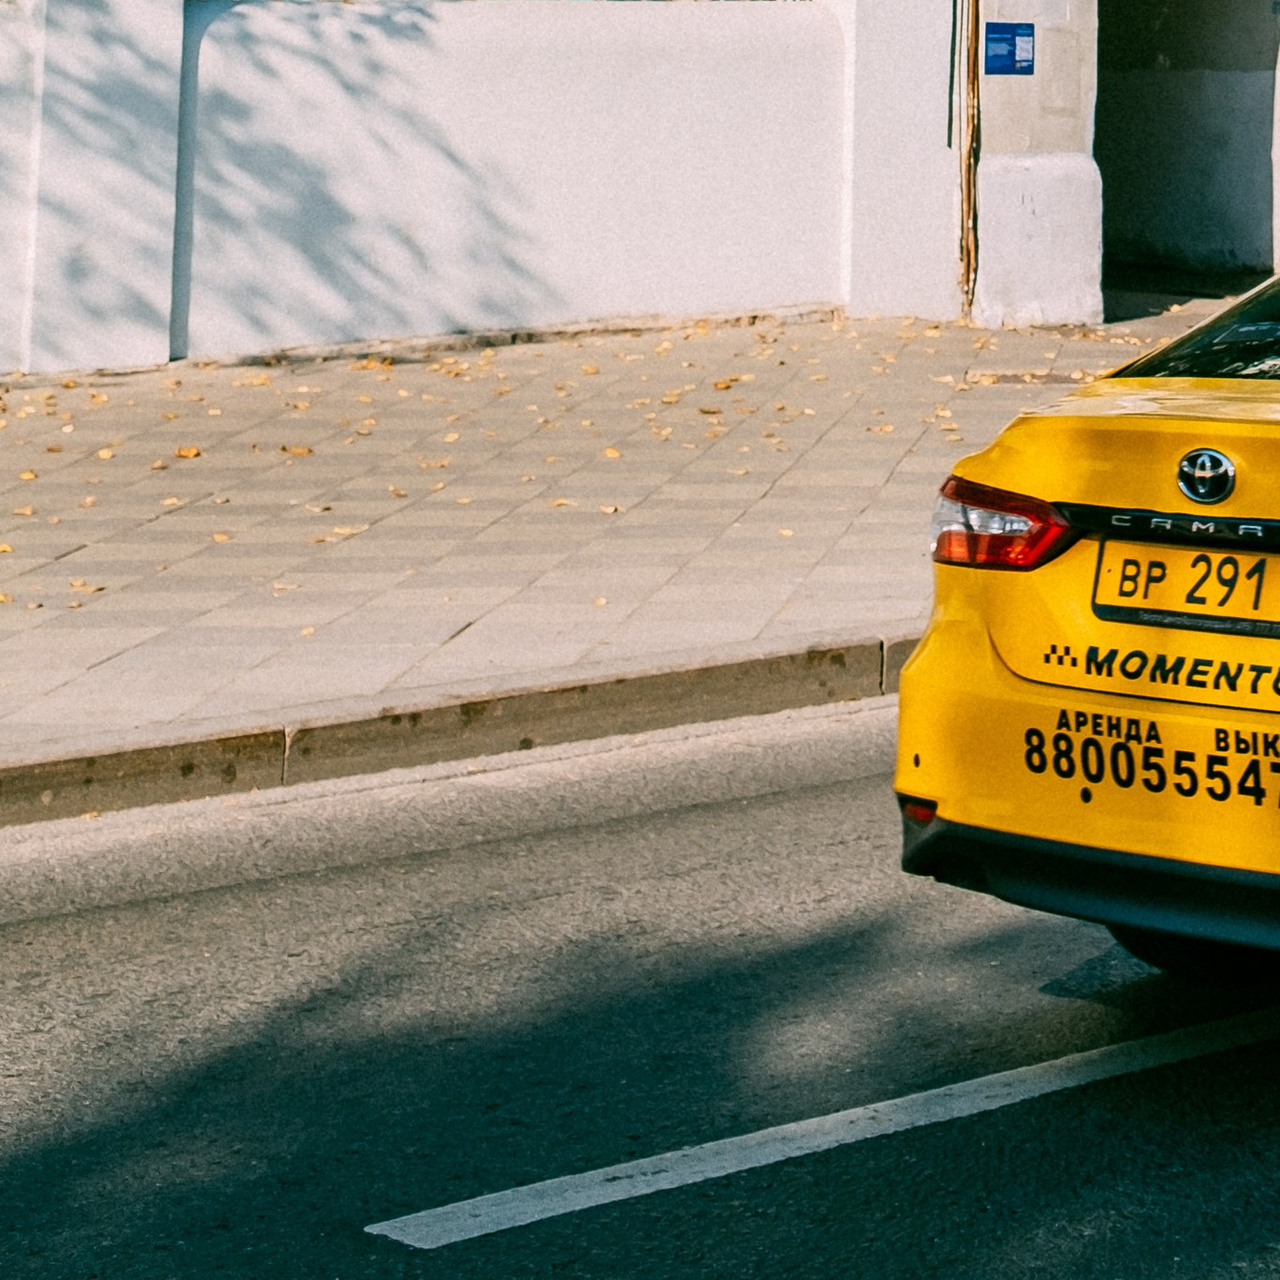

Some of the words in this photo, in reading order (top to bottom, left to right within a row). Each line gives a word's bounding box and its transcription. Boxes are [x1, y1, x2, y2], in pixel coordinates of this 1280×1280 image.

[1118, 558, 1168, 600] ВР
[1185, 553, 1268, 611] 291
[1056, 708, 1162, 745] АРЕНДА
